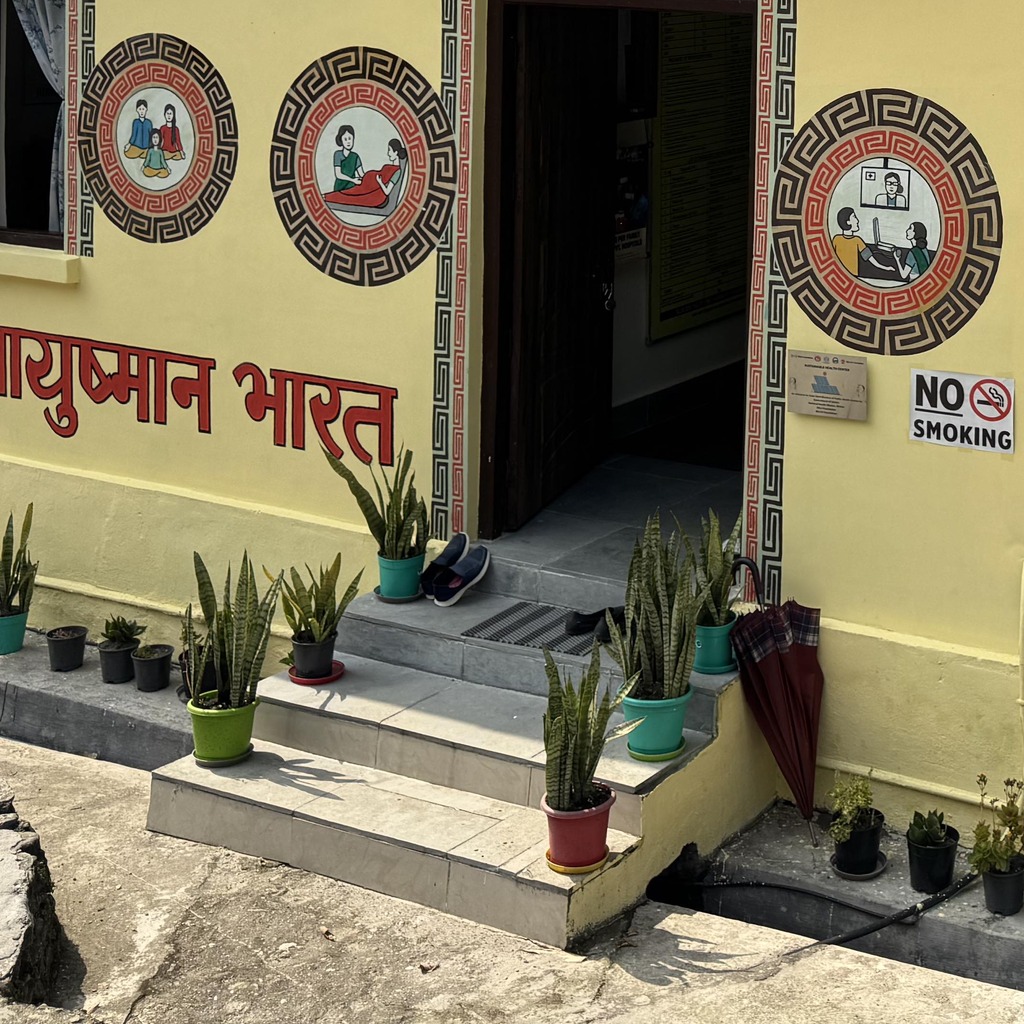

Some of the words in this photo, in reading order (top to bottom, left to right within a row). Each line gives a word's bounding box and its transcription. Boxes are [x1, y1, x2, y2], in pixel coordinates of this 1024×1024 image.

[915, 374, 965, 411] NO
[232, 362, 398, 467] भारत
[913, 419, 1012, 450] SMOKING
